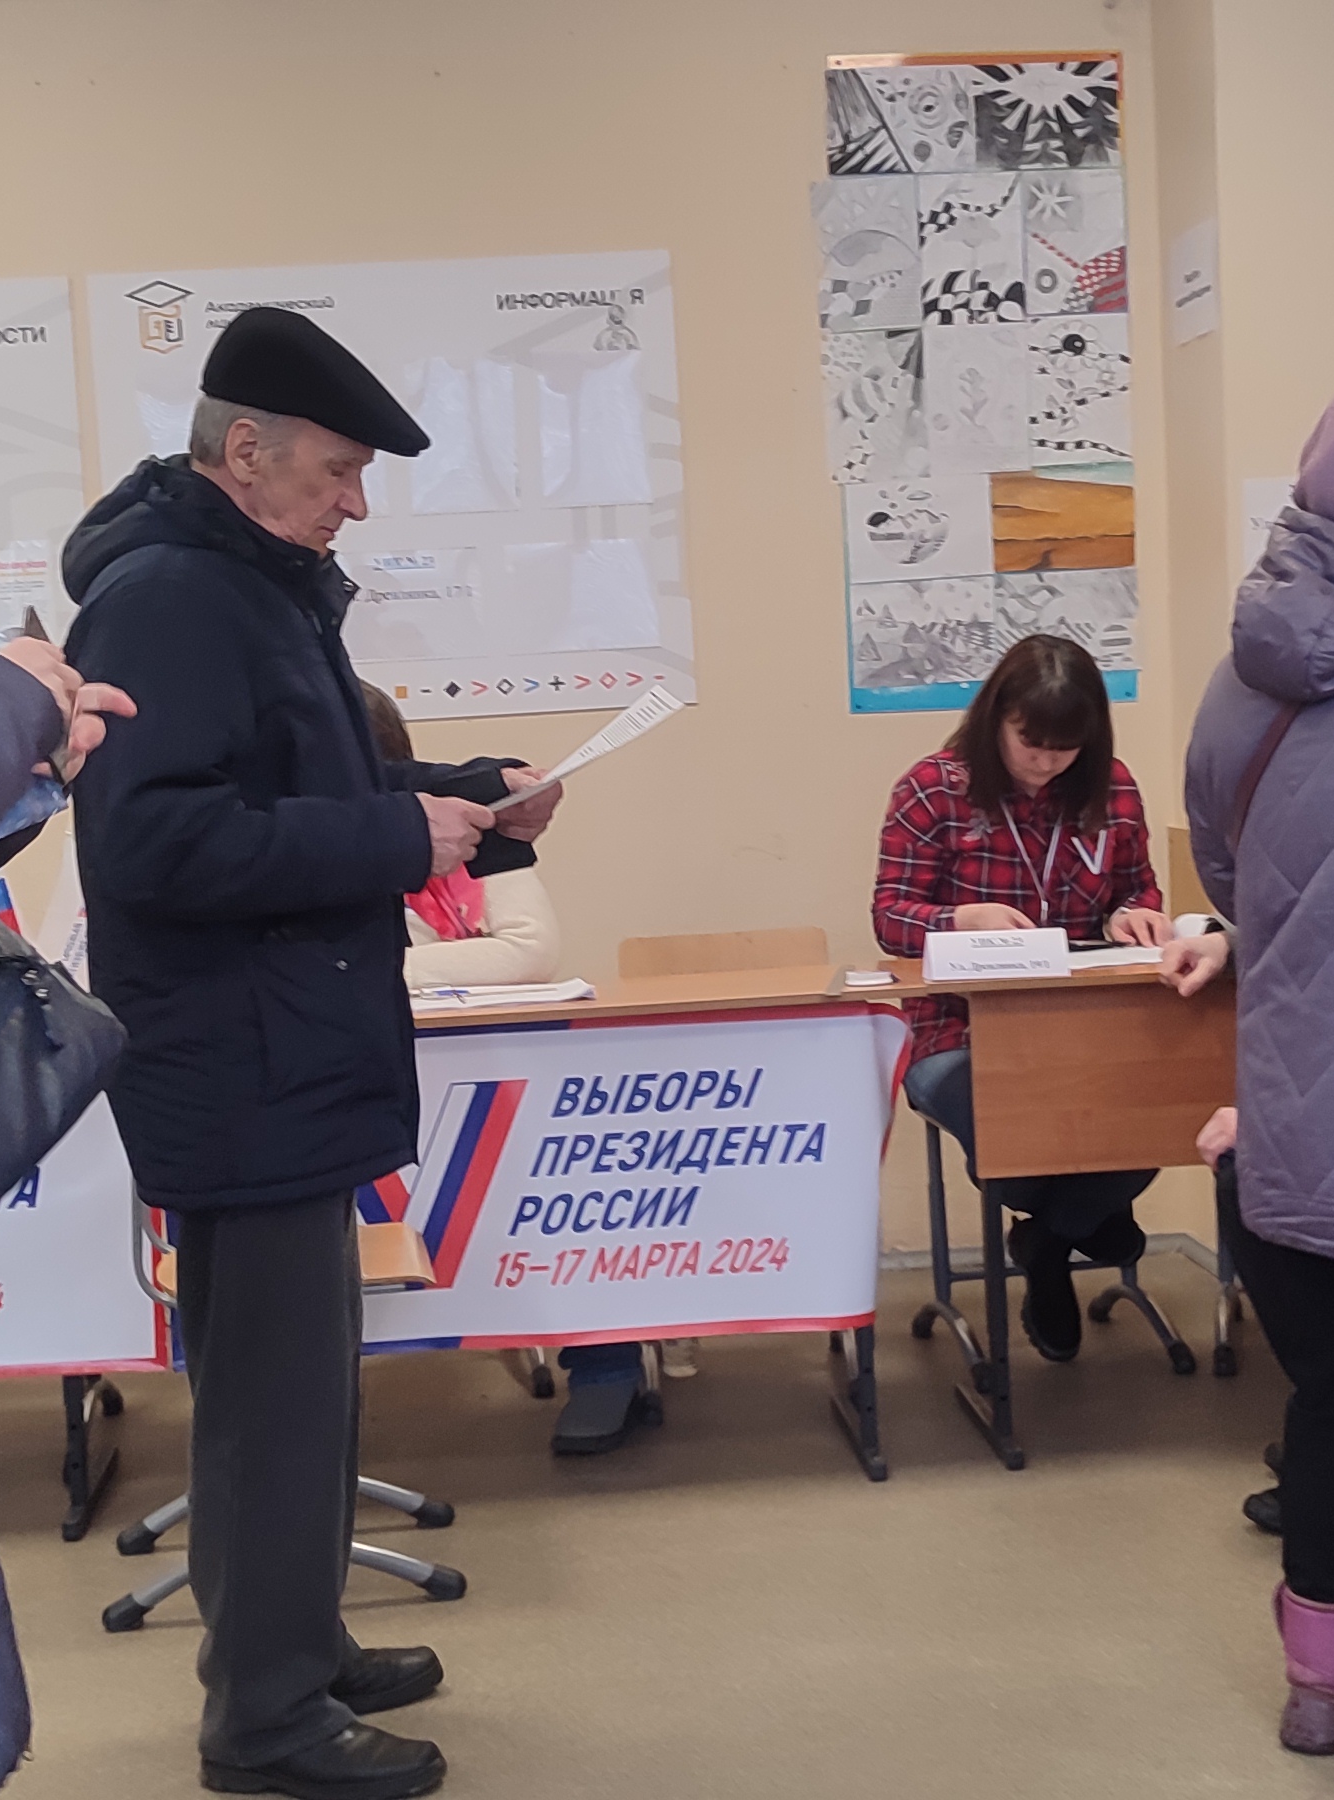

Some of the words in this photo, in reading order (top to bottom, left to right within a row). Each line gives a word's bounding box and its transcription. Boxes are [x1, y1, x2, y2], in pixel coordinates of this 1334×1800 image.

[551, 1068, 764, 1118] ВЫБОРЫ
[529, 1122, 827, 1178] ПРЕЗИДЕНТА
[508, 1185, 700, 1236] РОССИИ
[589, 1240, 701, 1283] МАРТА
[706, 1236, 790, 1275] 2024
